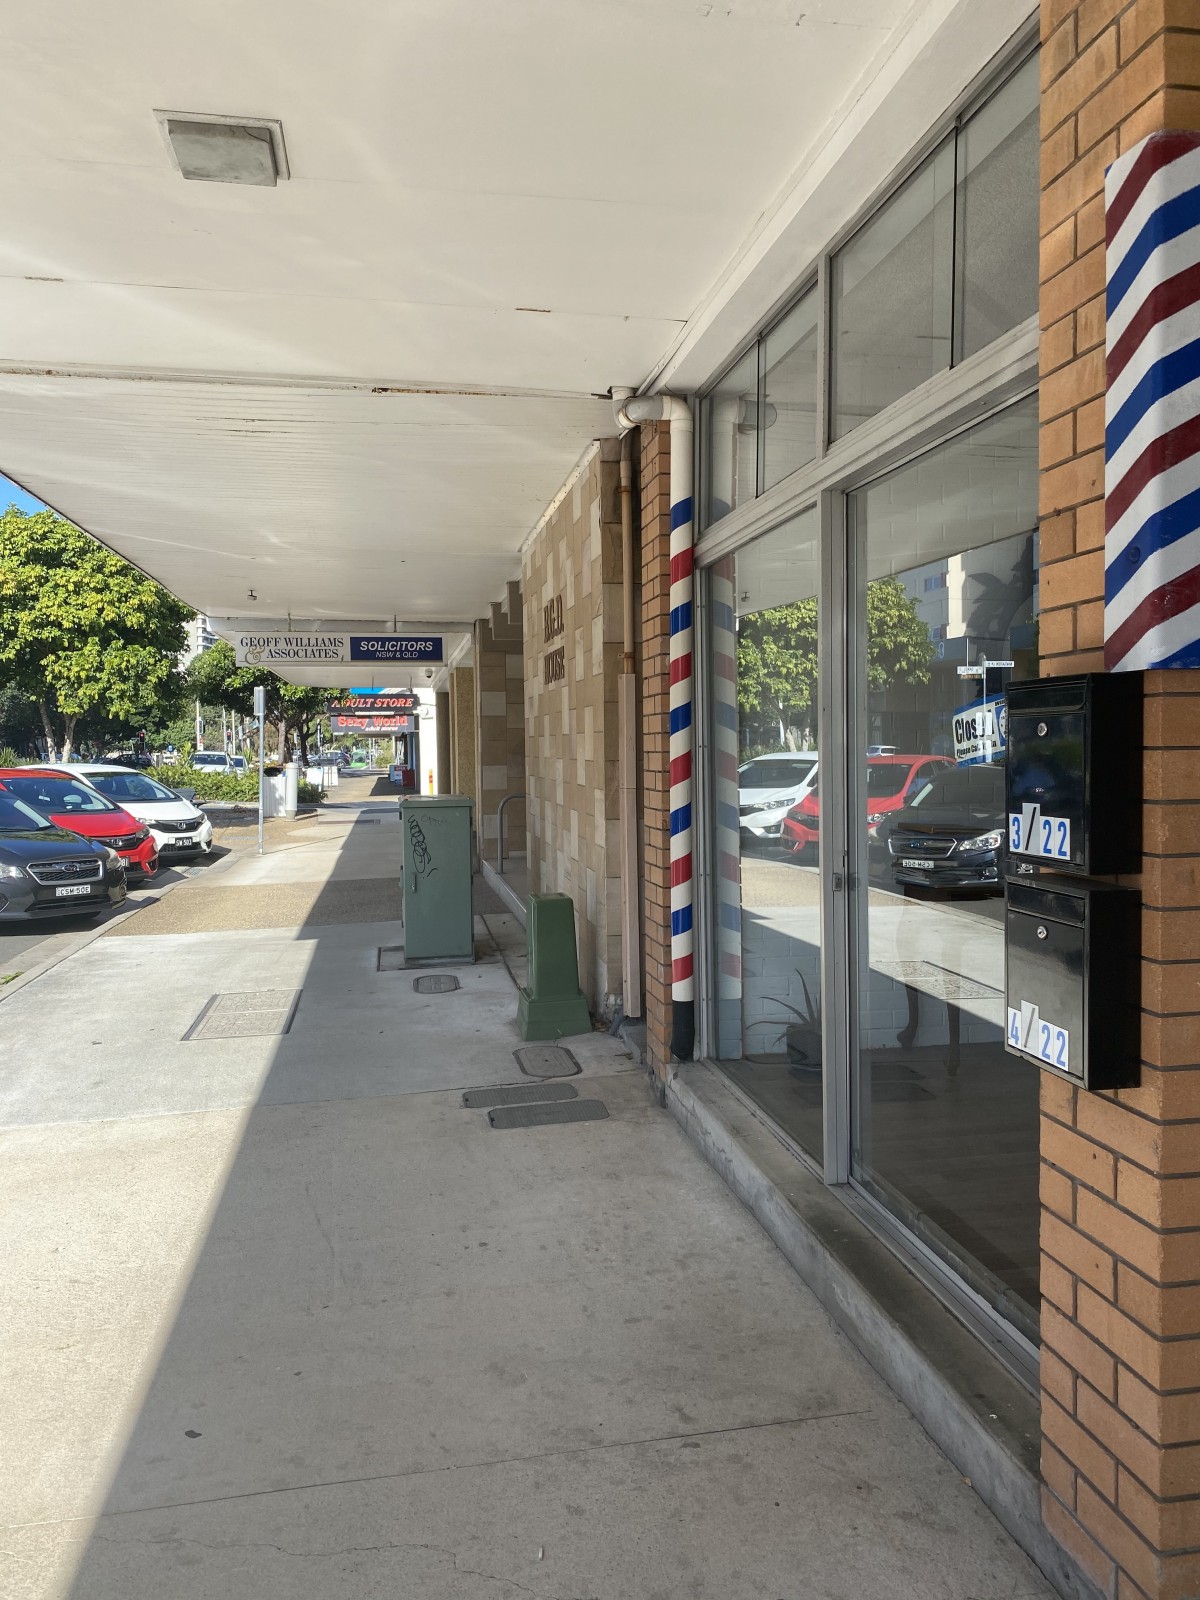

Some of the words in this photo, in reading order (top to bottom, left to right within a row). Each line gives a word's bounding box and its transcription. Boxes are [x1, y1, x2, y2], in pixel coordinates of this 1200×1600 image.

[240, 637, 282, 647] GEOFF
[284, 637, 344, 647] WILLIAMS
[360, 641, 433, 651] SOLICITORS
[266, 648, 339, 659] ASSOCIATES
[374, 698, 414, 708] STORE
[337, 716, 369, 729] Sexy
[372, 715, 408, 726] World
[1011, 806, 1068, 857] 3/22
[1010, 1007, 1066, 1067] 4/22
